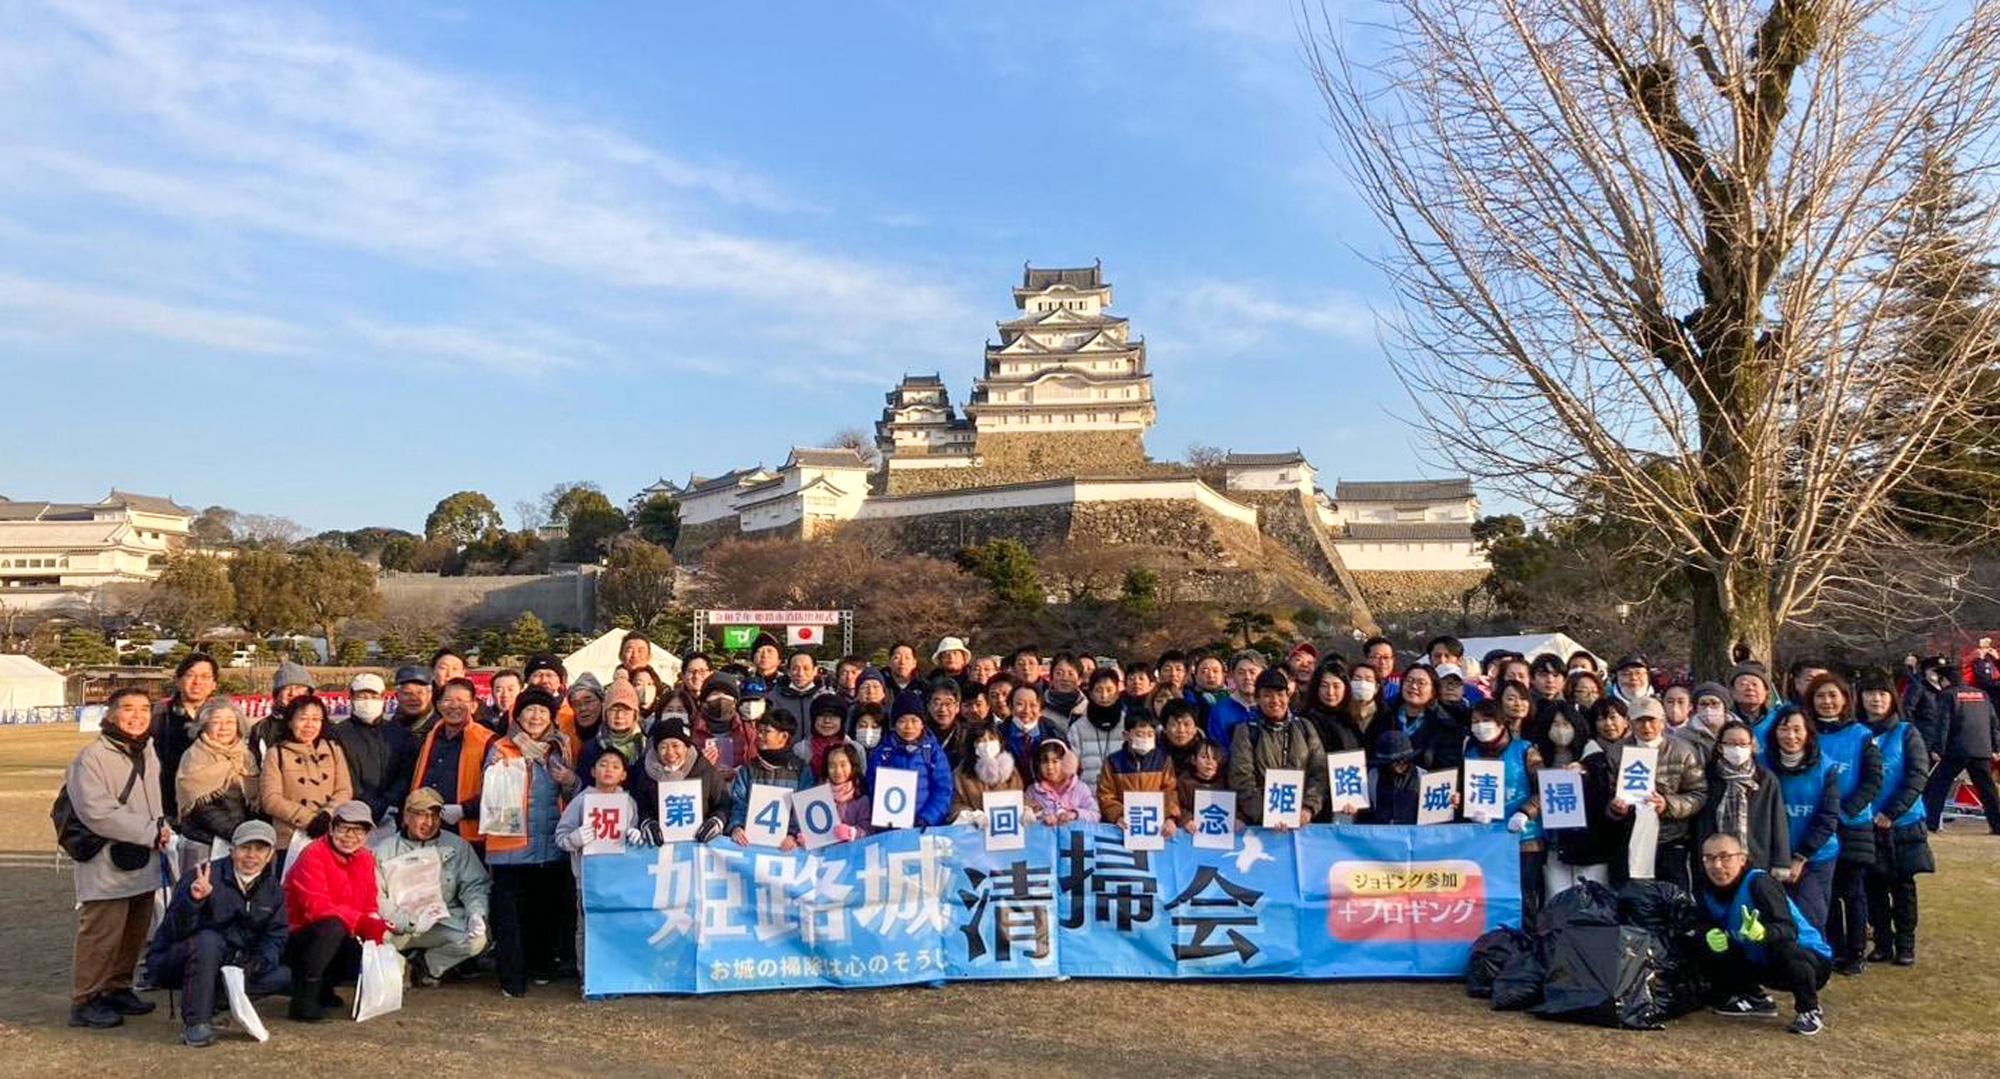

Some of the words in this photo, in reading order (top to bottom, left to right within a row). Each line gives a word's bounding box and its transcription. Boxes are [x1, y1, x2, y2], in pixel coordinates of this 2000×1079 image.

[1334, 766, 1363, 797] 路
[1469, 773, 1499, 805] 清
[1623, 759, 1651, 792] 会
[664, 794, 696, 828] 第
[884, 786, 907, 814] 0
[1268, 783, 1297, 813] 姫
[1422, 782, 1451, 810] 城
[1544, 782, 1577, 814] 掃
[589, 807, 621, 840] 祝
[754, 799, 782, 834] 4
[805, 799, 833, 835] 0
[989, 806, 1019, 837] 回
[1129, 806, 1159, 837] 記
[1198, 803, 1231, 834] 念
[1353, 871, 1458, 889] ジョギング参加
[647, 829, 1263, 964] 姫路城清掃会
[709, 947, 949, 983] お城の掃除は心のそうじ
